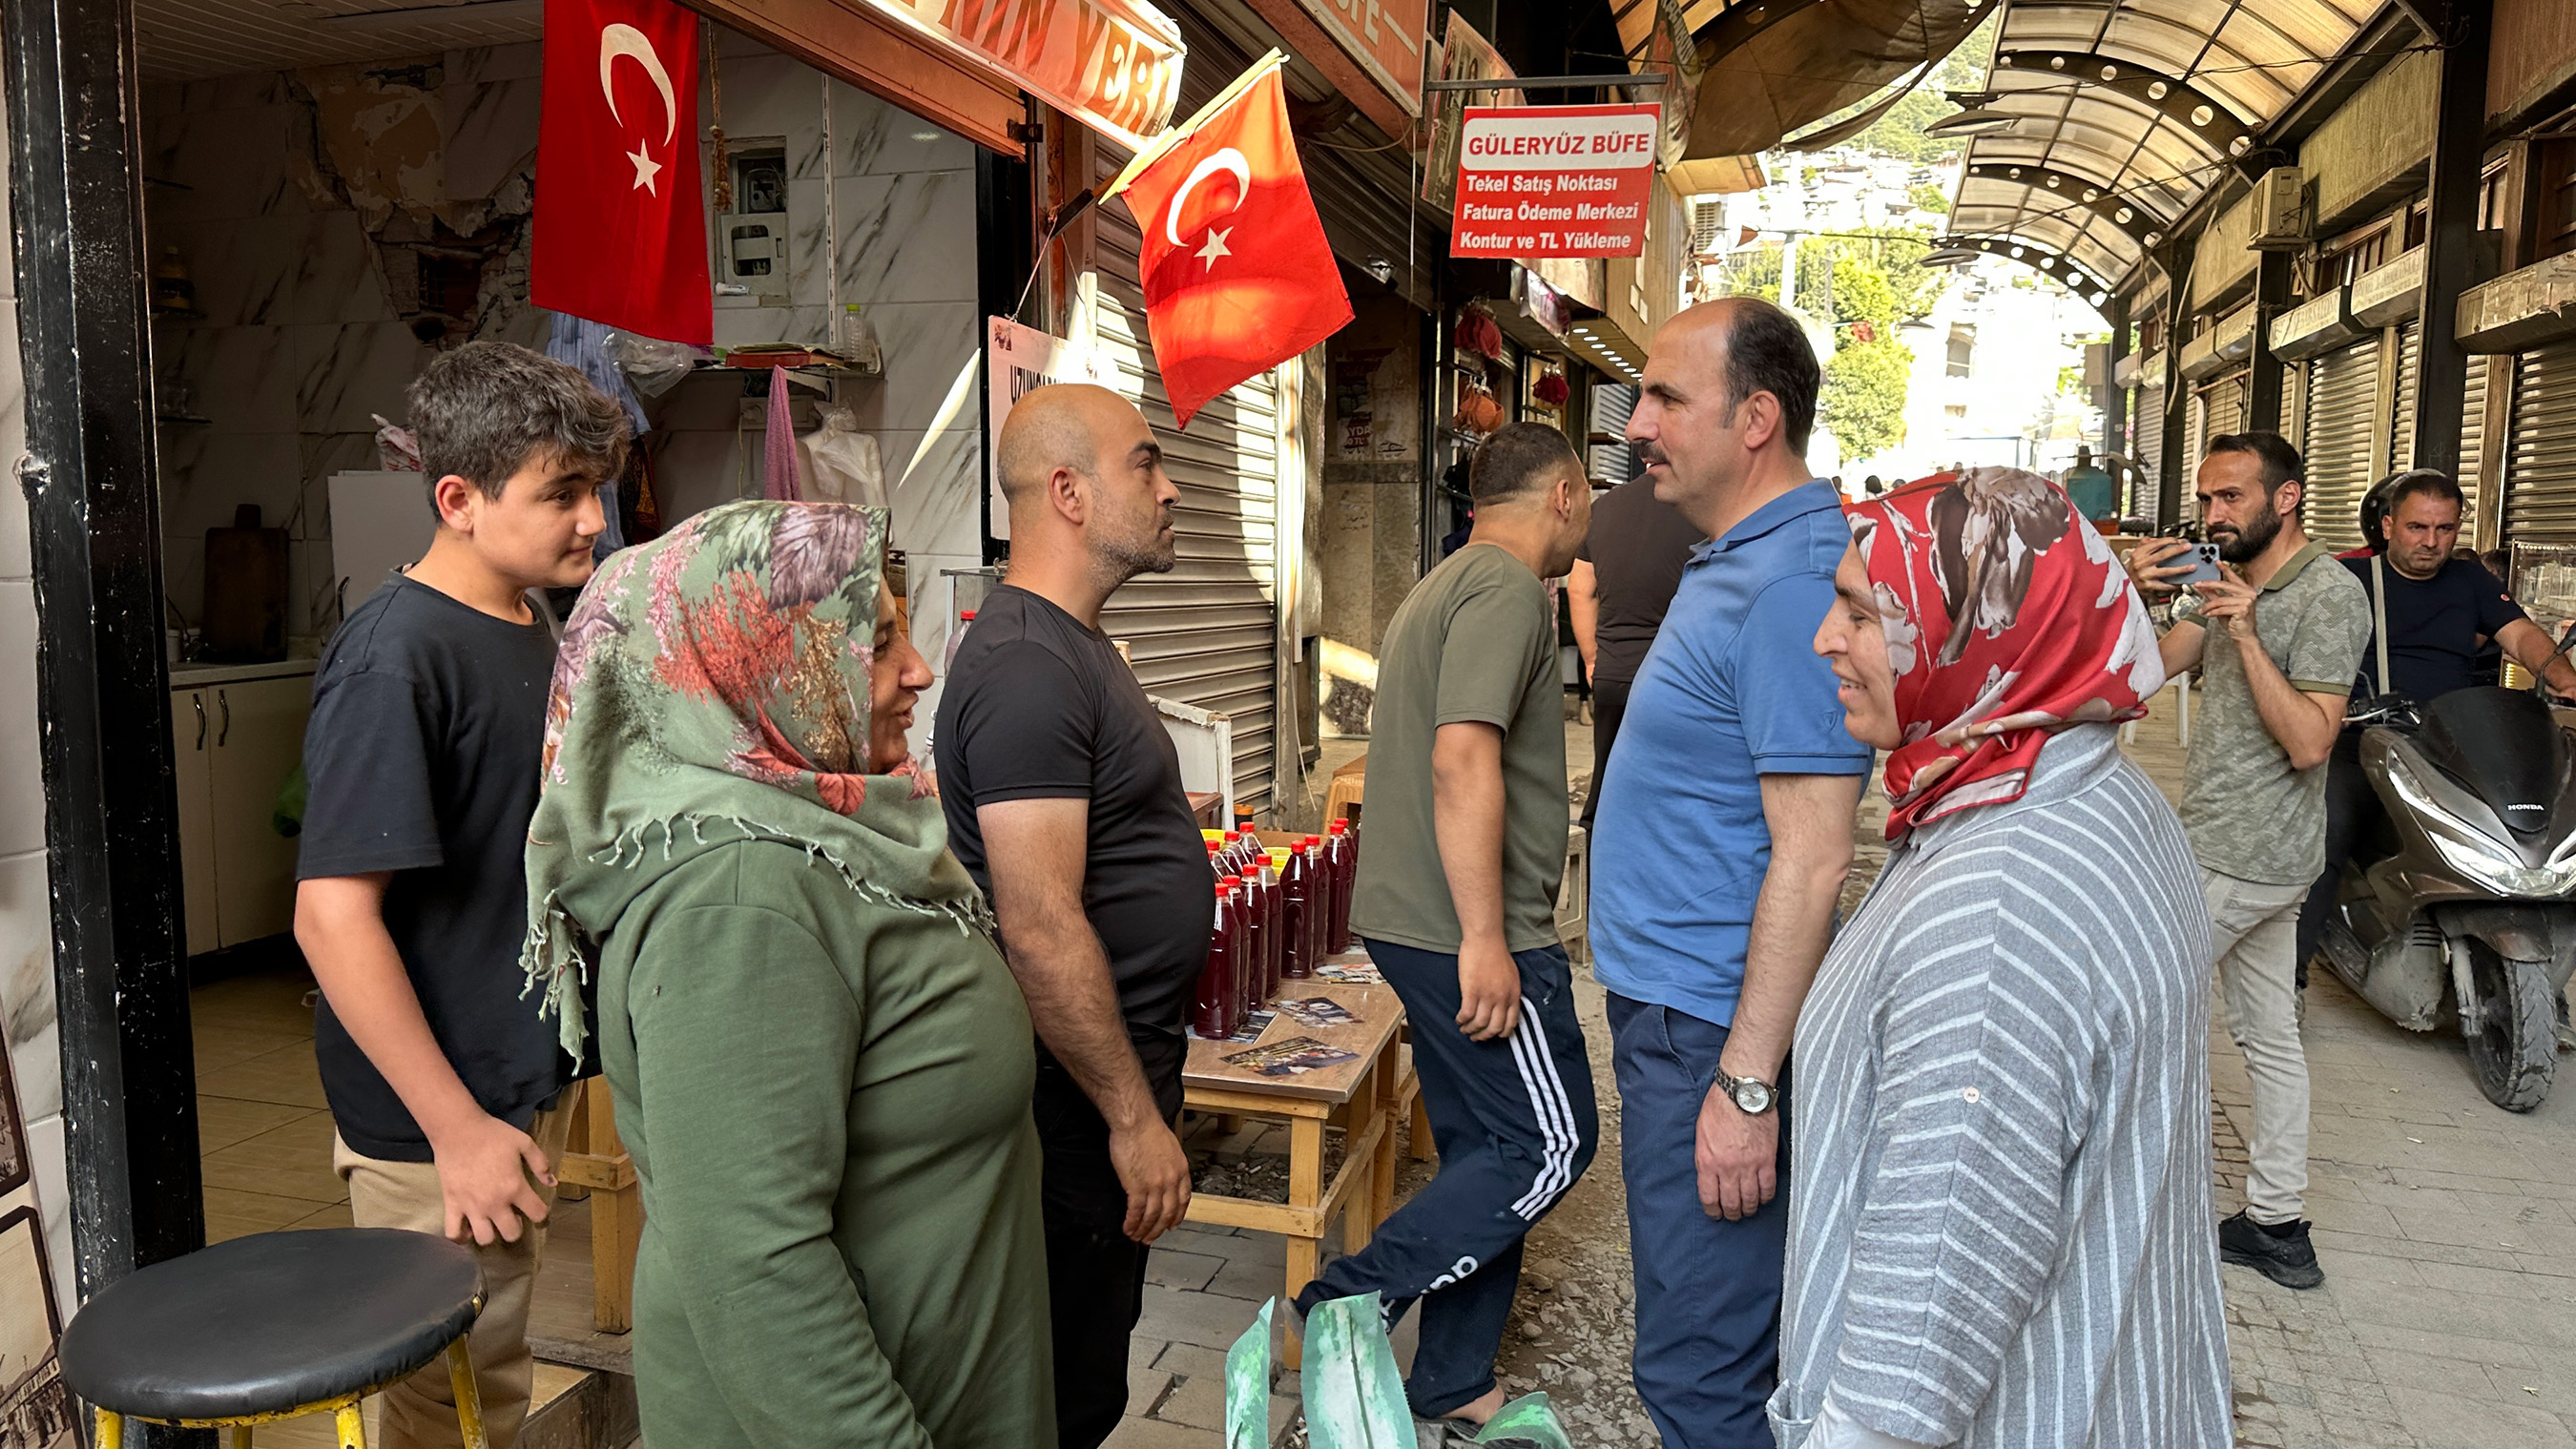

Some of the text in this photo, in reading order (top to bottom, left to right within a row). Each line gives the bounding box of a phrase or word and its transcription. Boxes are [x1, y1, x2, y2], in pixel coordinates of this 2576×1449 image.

[1468, 131, 1650, 155] GÜLERYÜZ BÜFE
[1466, 175, 1618, 196] Tekel Satış Noktası
[1463, 200, 1639, 220] Fatura Ödeme Merkezi
[1460, 231, 1631, 249] Kontur ve TL Yükleme
